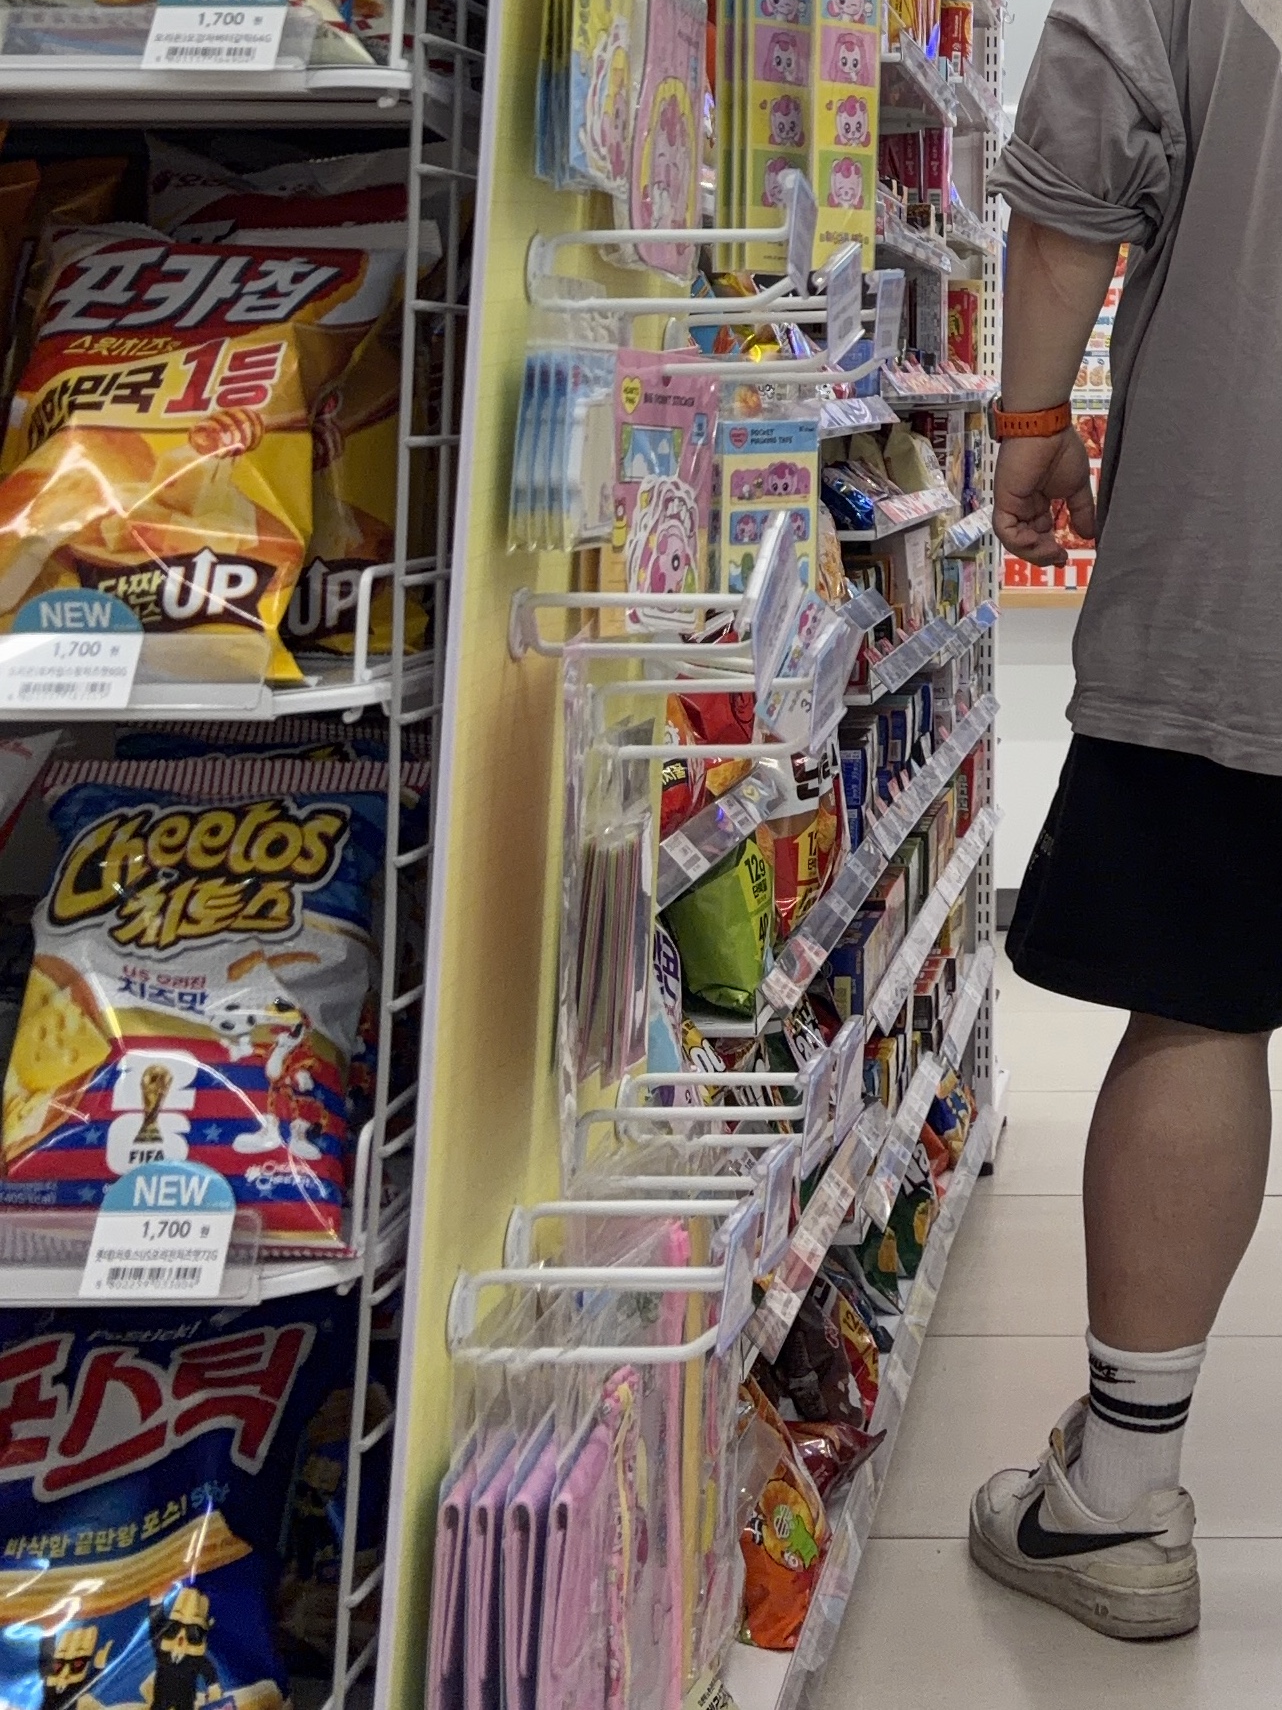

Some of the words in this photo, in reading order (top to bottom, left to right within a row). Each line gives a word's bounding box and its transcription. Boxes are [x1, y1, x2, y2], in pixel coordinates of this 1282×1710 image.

[198, 12, 245, 27] 1,700
[163, 547, 257, 619] UP
[39, 601, 114, 628] NEW
[53, 641, 101, 657] 1,700
[49, 800, 345, 926] Cheetos
[112, 877, 292, 946] 치토스
[117, 976, 209, 1015] 치즈맛
[128, 1149, 165, 1163] FIFA
[132, 1174, 210, 1208] NEW
[142, 1220, 192, 1241] 1,700
